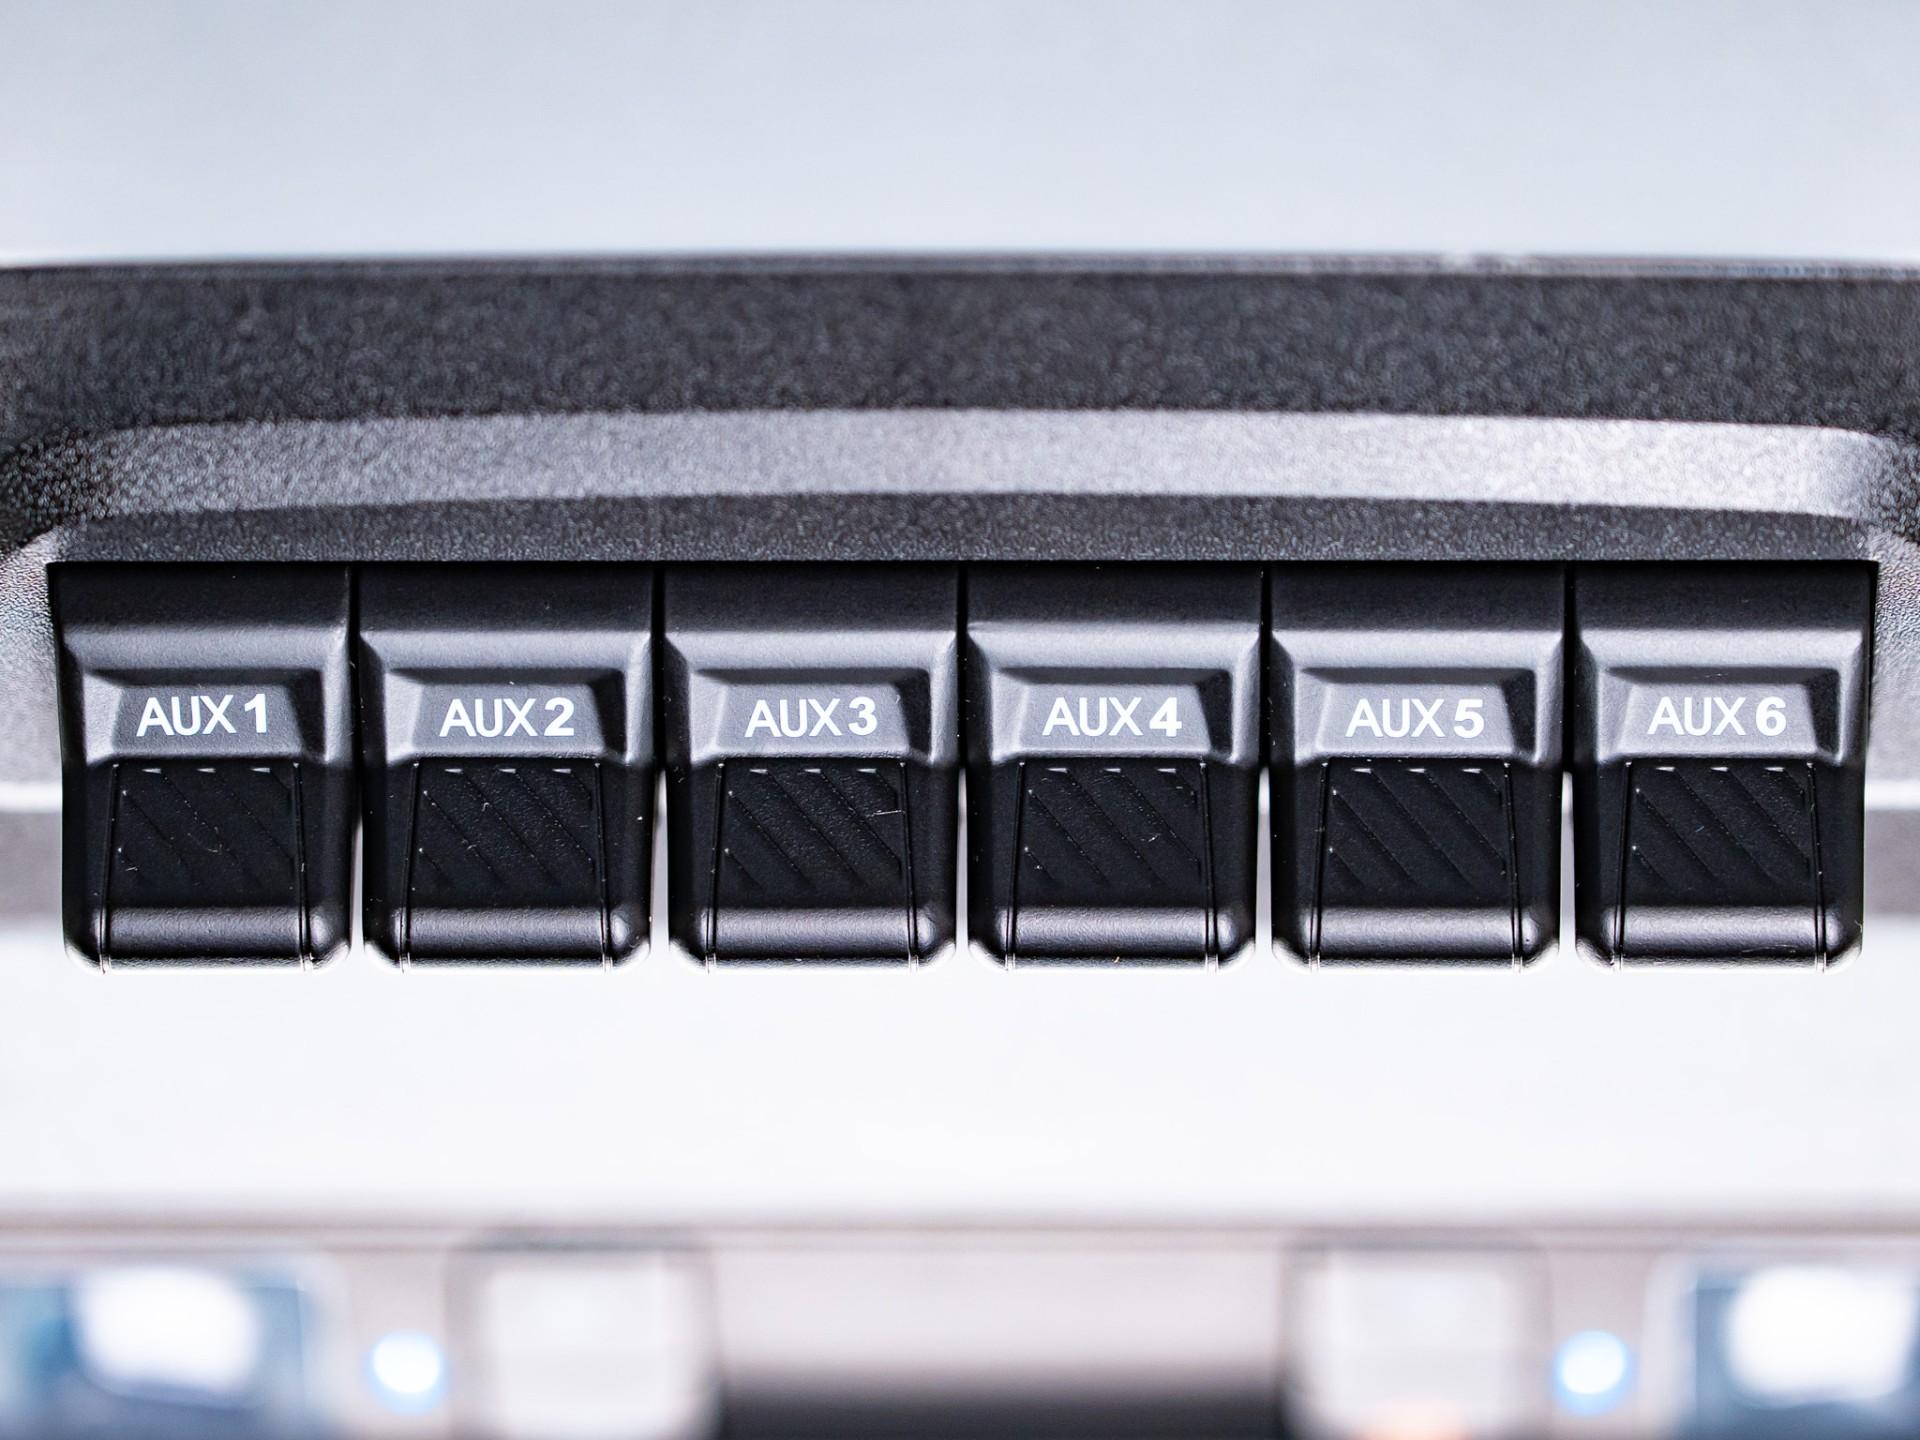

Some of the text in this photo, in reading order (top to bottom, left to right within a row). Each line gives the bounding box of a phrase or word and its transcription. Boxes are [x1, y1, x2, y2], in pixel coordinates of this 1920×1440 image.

[137, 693, 267, 736] AUX 1
[439, 696, 575, 738] AUX 2
[744, 696, 879, 738] AUX 3
[1041, 695, 1183, 737] AUX 4
[1345, 697, 1485, 739] AUX 5
[1647, 695, 1788, 737] AUX 6
